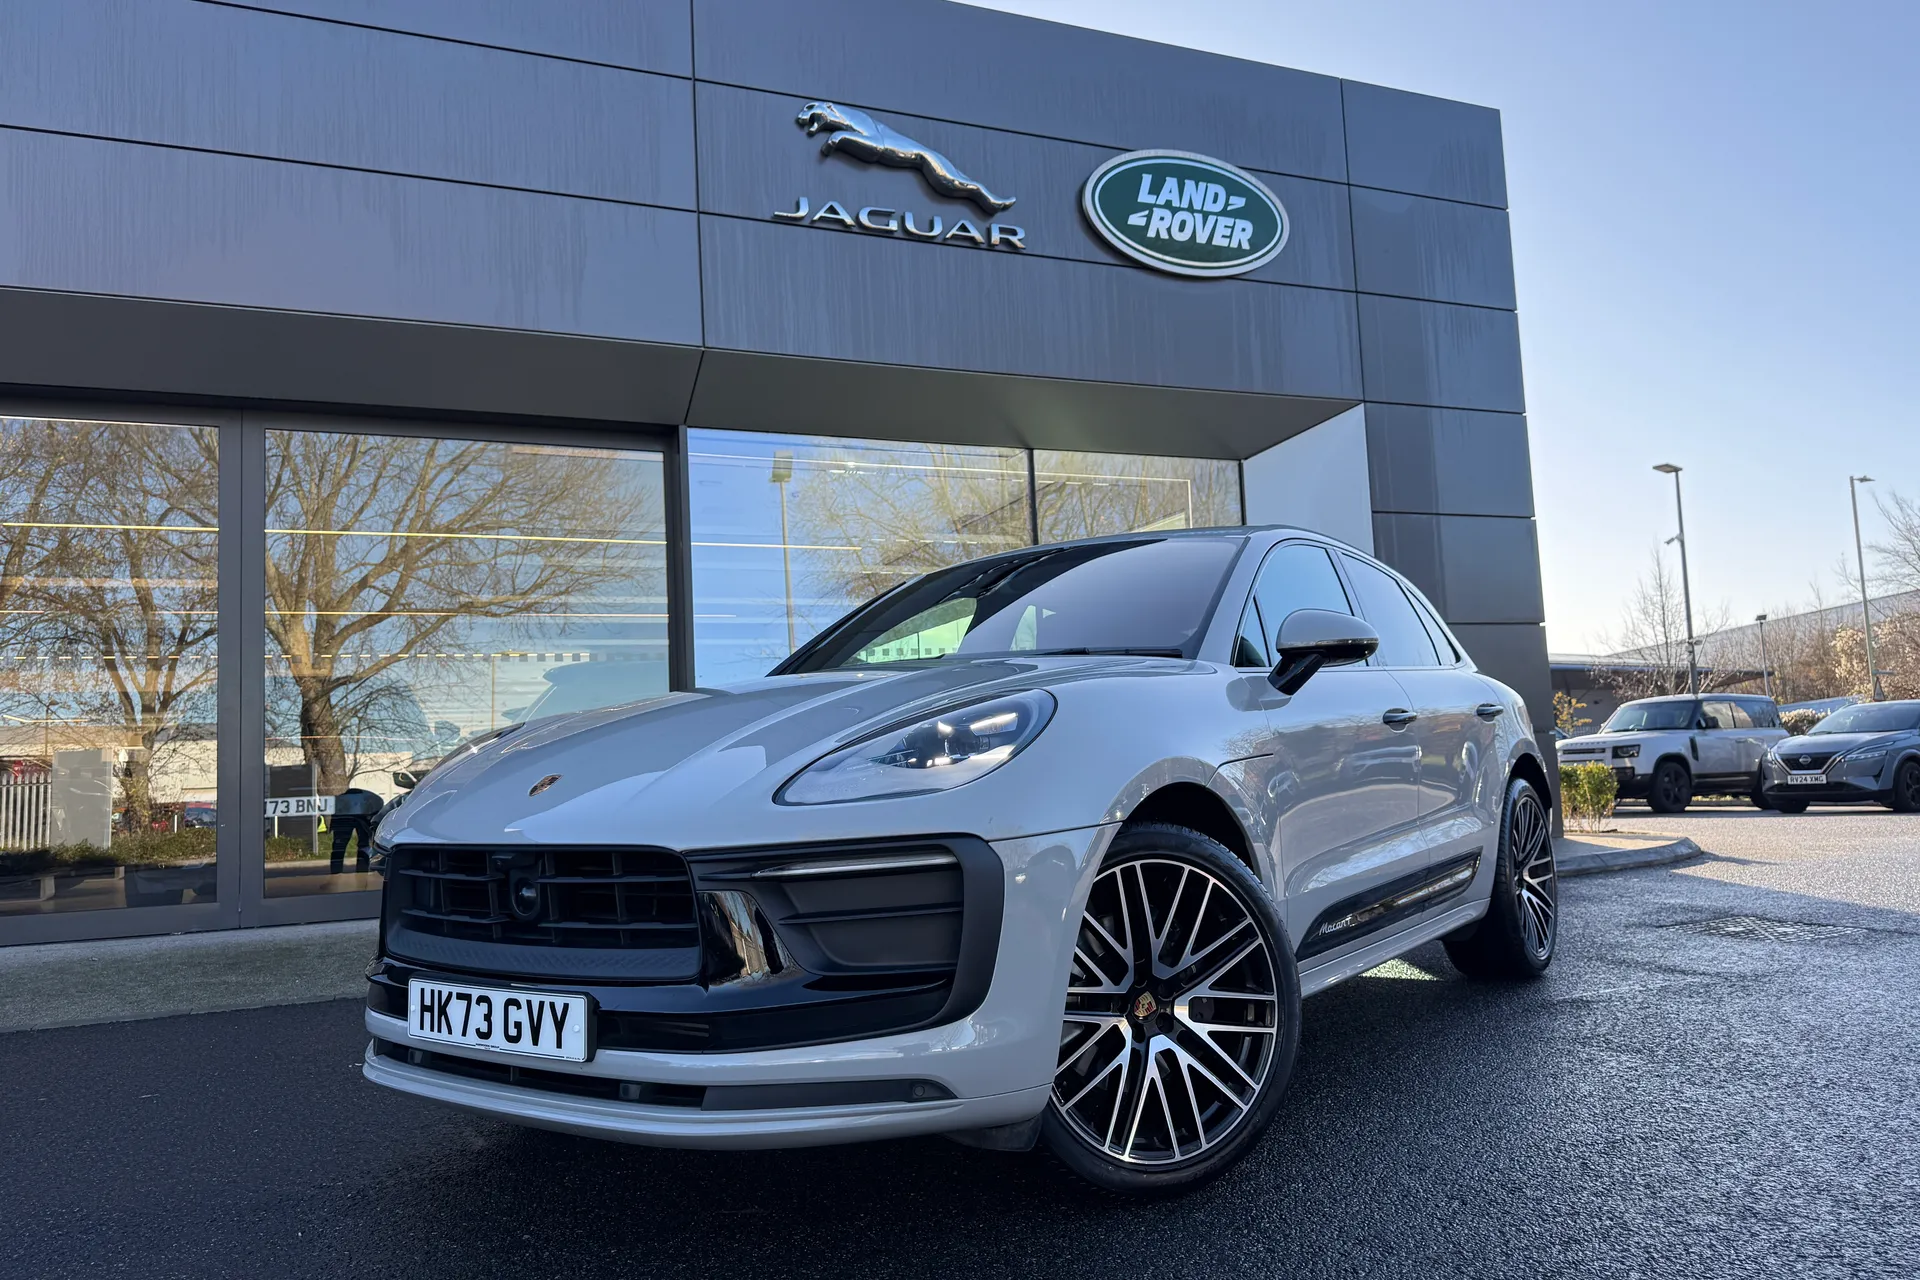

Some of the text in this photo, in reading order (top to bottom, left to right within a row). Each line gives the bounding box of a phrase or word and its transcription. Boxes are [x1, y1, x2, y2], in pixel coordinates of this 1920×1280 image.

[1137, 173, 1227, 213] LAND
[774, 196, 1027, 250] JAGUAR
[1145, 207, 1254, 251] ROVER
[1318, 919, 1346, 936] Macan
[419, 987, 570, 1050] HK73 GVY
